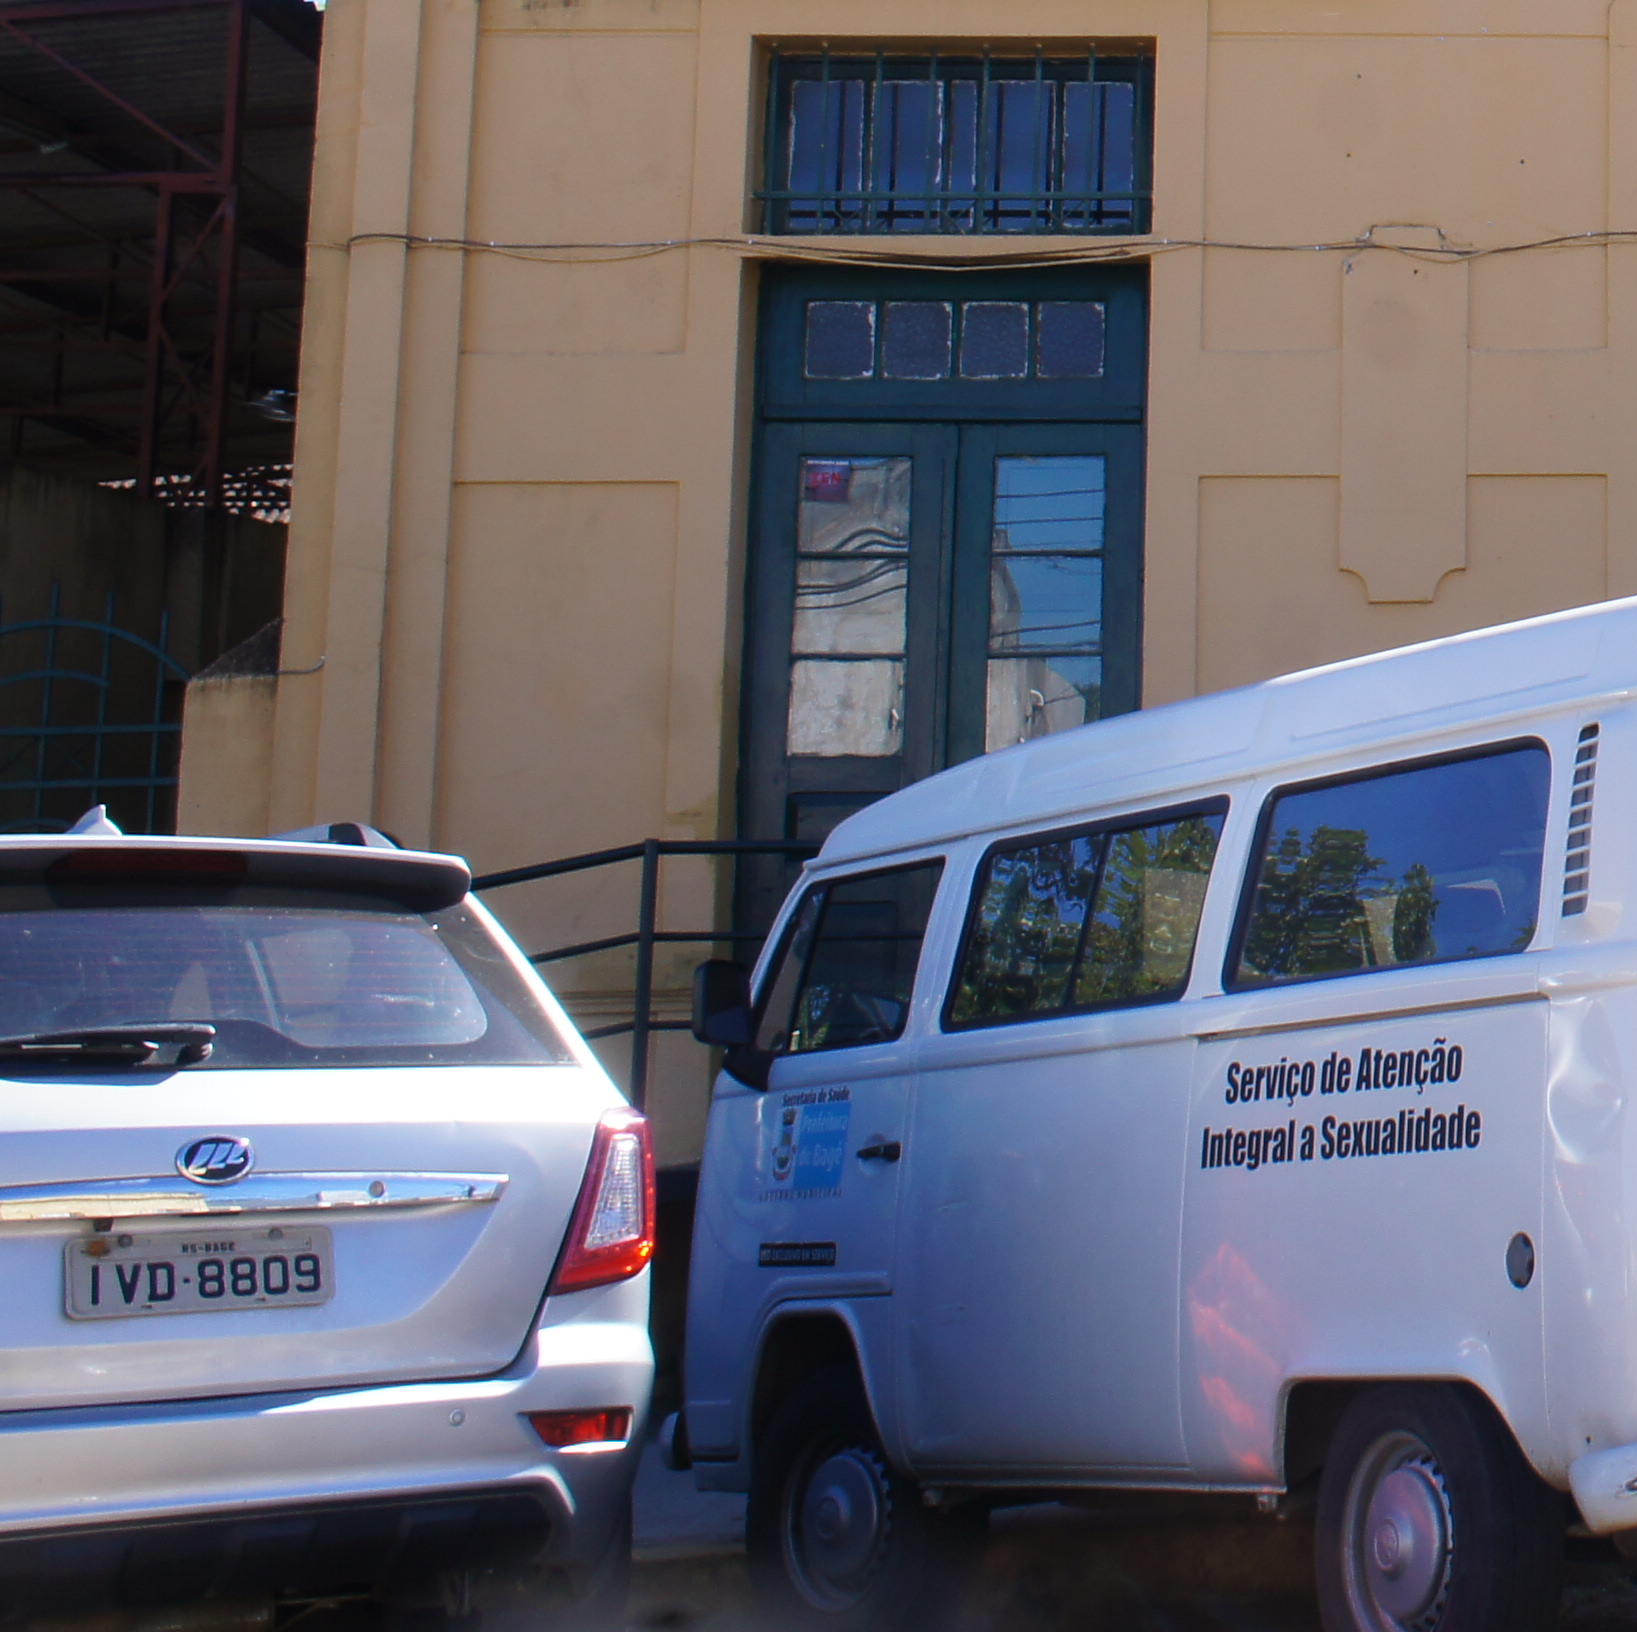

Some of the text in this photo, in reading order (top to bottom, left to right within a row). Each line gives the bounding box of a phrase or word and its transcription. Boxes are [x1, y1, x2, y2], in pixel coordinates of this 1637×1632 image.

[783, 1090, 817, 1107] Secretaria
[818, 1087, 827, 1103] de
[1225, 1036, 1463, 1107] Serviço de Atenção
[1201, 1104, 1482, 1170] Integral a Sexualidade
